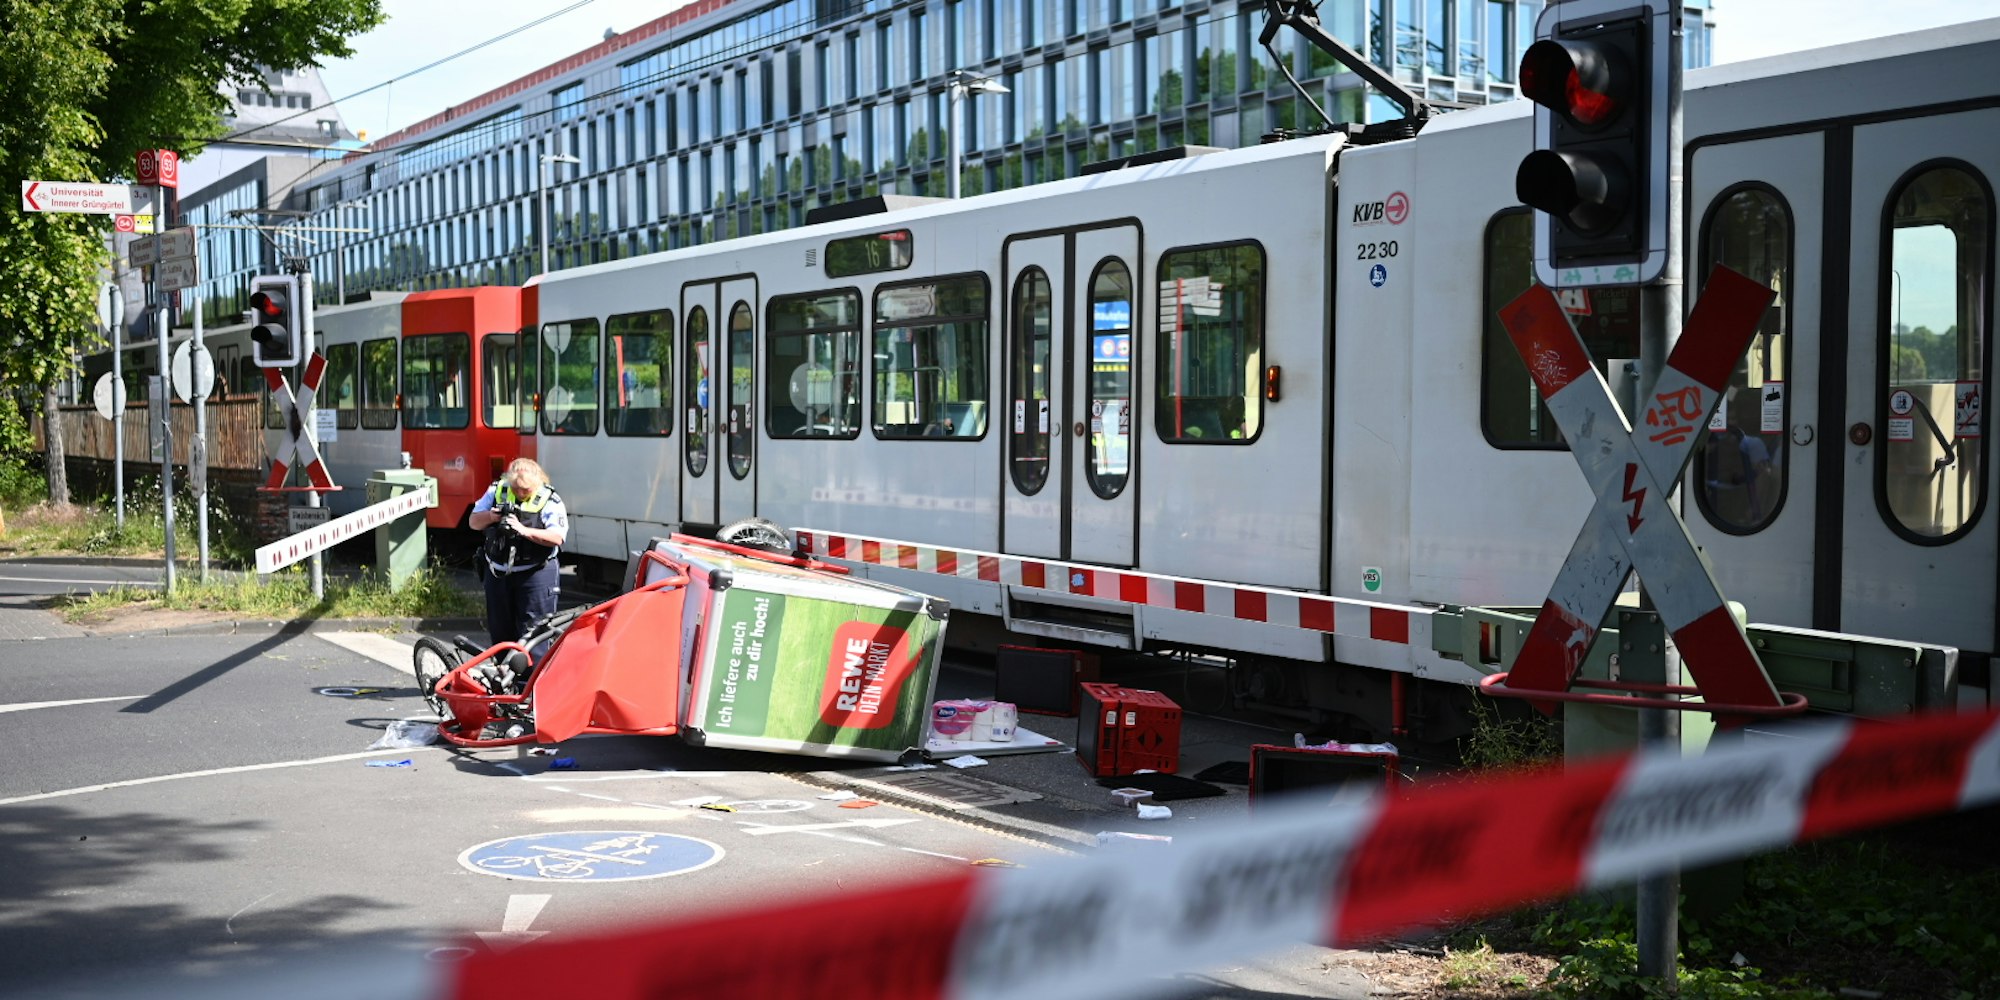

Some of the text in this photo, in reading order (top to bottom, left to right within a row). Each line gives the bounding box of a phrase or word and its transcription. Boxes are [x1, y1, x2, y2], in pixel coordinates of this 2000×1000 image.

[50, 187, 104, 197] Universität
[51, 198, 125, 210] Innerer Grüngürtel
[1353, 202, 1384, 223] KVB
[865, 240, 880, 269] 16
[1357, 240, 1399, 261] 2230
[1362, 573, 1377, 582] VRS
[747, 597, 770, 681] zu dir hoch!
[716, 620, 748, 728] Ich liefere auch
[836, 638, 869, 712] REWE
[859, 641, 890, 715] DEIN MARKT
